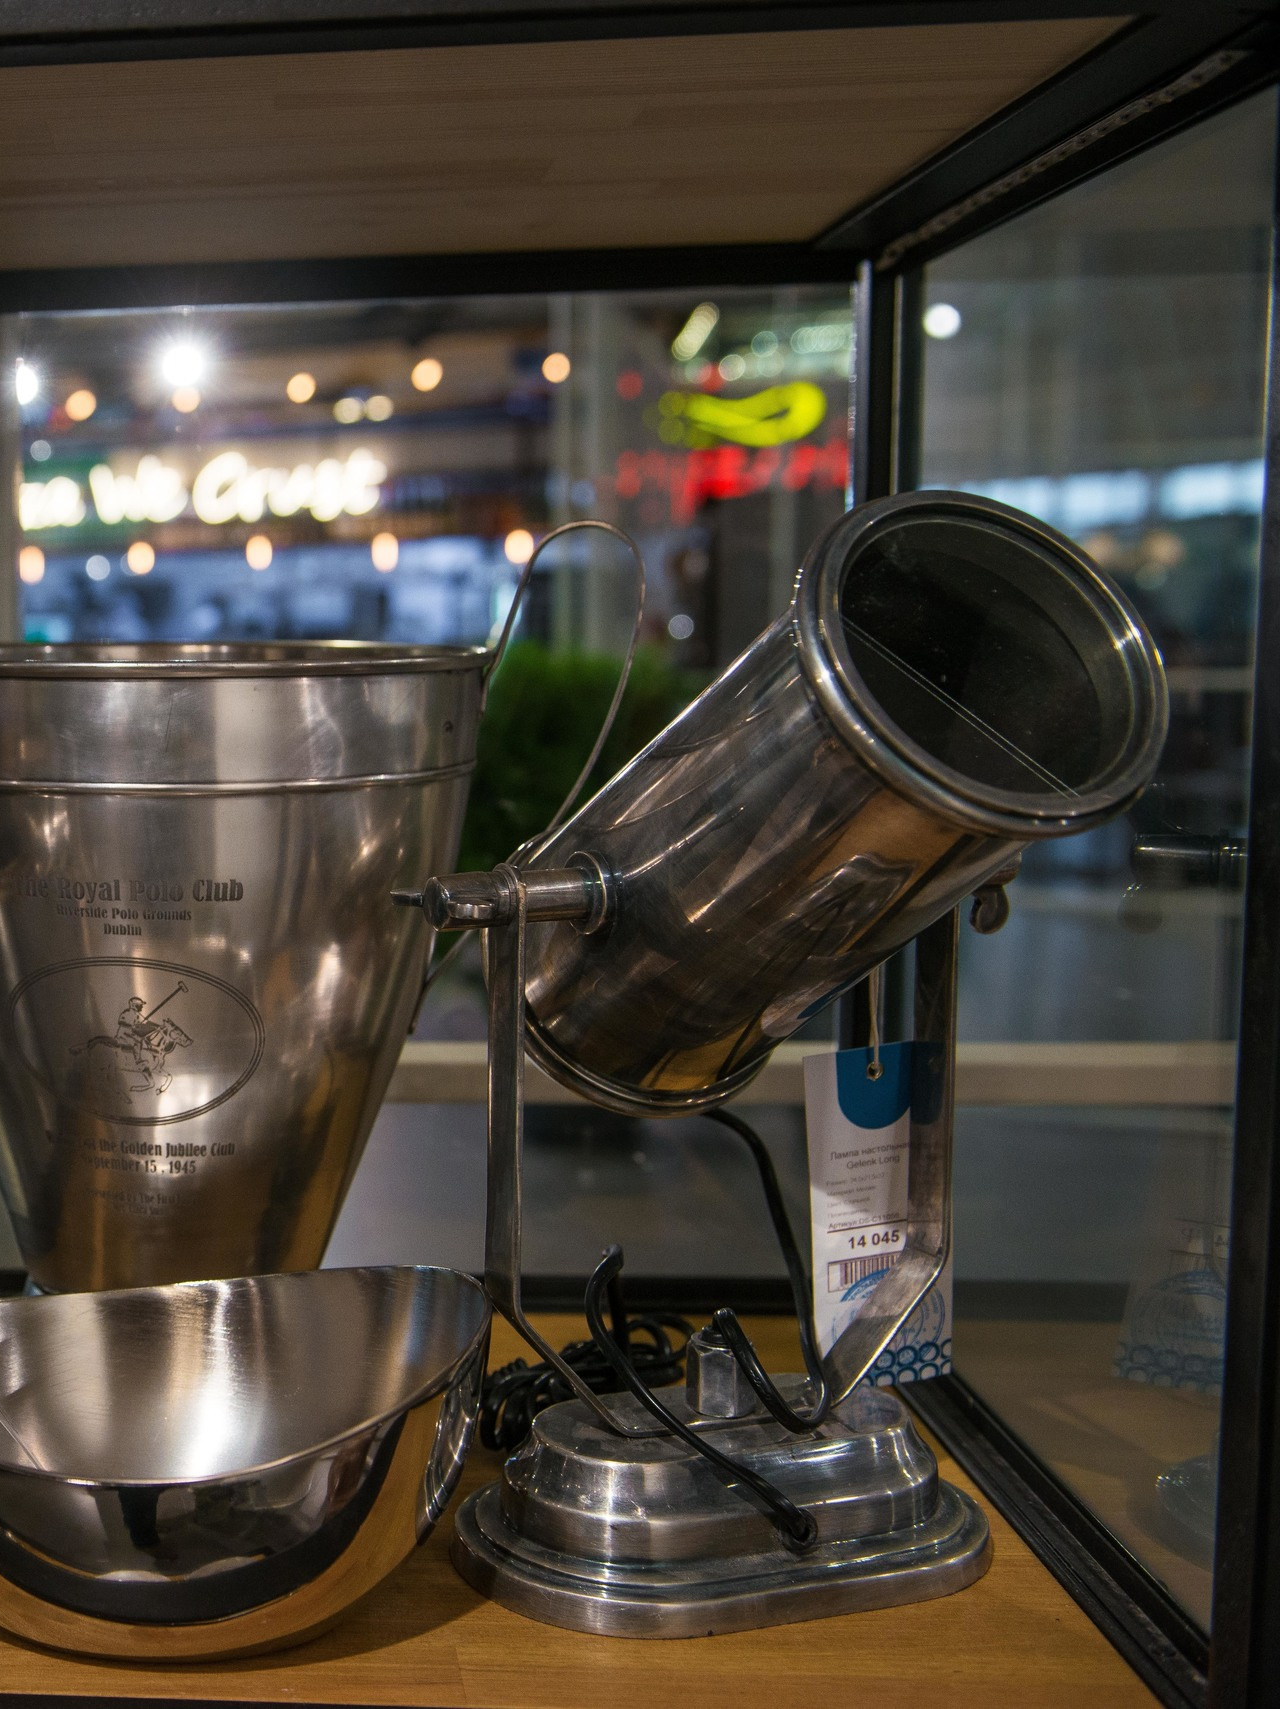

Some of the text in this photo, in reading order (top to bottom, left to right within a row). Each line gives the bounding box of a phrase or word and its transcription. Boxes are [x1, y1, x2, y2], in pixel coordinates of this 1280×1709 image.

[128, 879, 184, 902] Polo
[192, 878, 244, 902] Club
[112, 907, 139, 921] Polo
[103, 923, 142, 936] Dublin
[121, 1141, 162, 1157] Golden
[165, 1142, 207, 1159] Jubilee
[210, 1141, 236, 1157] Club
[144, 1159, 157, 1174] 15
[169, 1160, 197, 1174] 1945
[848, 1229, 900, 1250] 14 045
